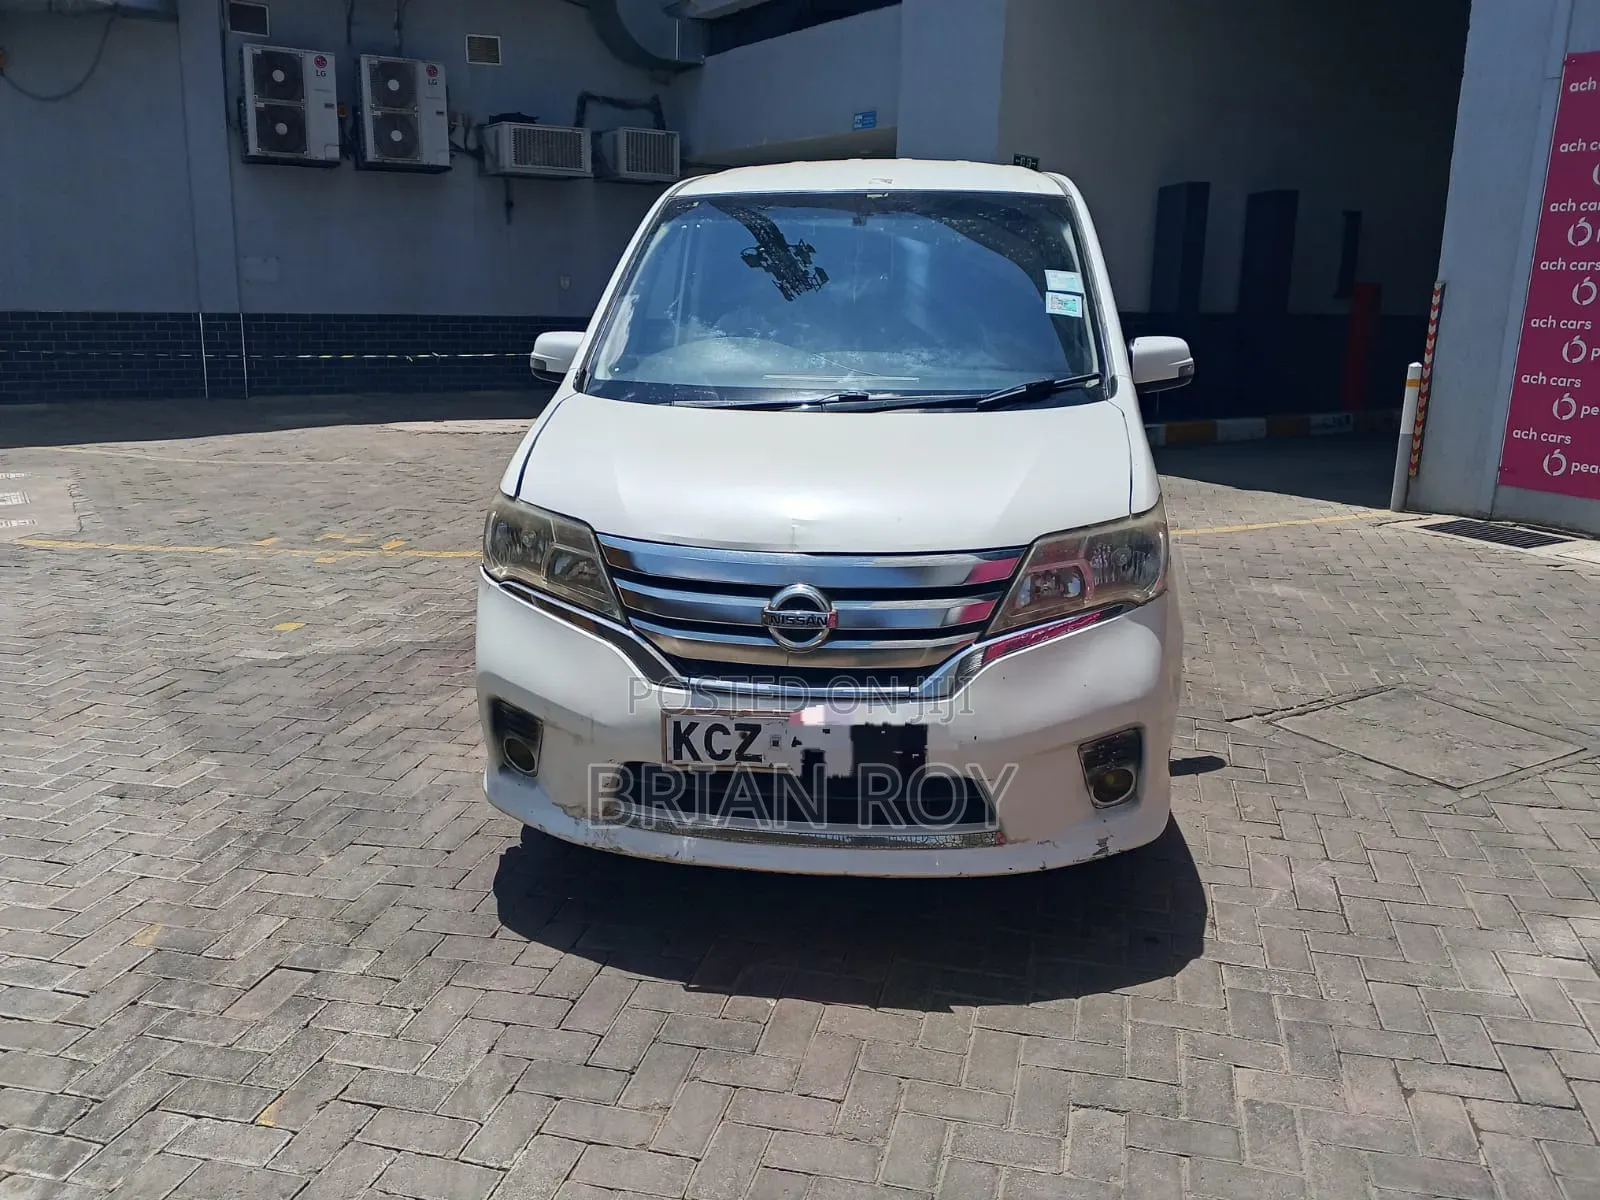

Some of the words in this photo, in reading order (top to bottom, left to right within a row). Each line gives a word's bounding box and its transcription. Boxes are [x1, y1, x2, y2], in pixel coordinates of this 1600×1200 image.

[315, 69, 326, 78] LG
[1569, 76, 1597, 91] ach
[1559, 138, 1587, 152] ach
[1550, 198, 1576, 212] ach
[1540, 257, 1566, 271] ach
[1531, 315, 1556, 329] ach
[1559, 319, 1592, 330] cars
[1521, 372, 1547, 385] ach
[1550, 376, 1582, 388] cars
[1512, 428, 1537, 441] ach
[1540, 432, 1572, 445] cars
[1570, 462, 1600, 475] pea
[770, 615, 828, 625] NISSAN
[673, 720, 763, 764] KCZ
